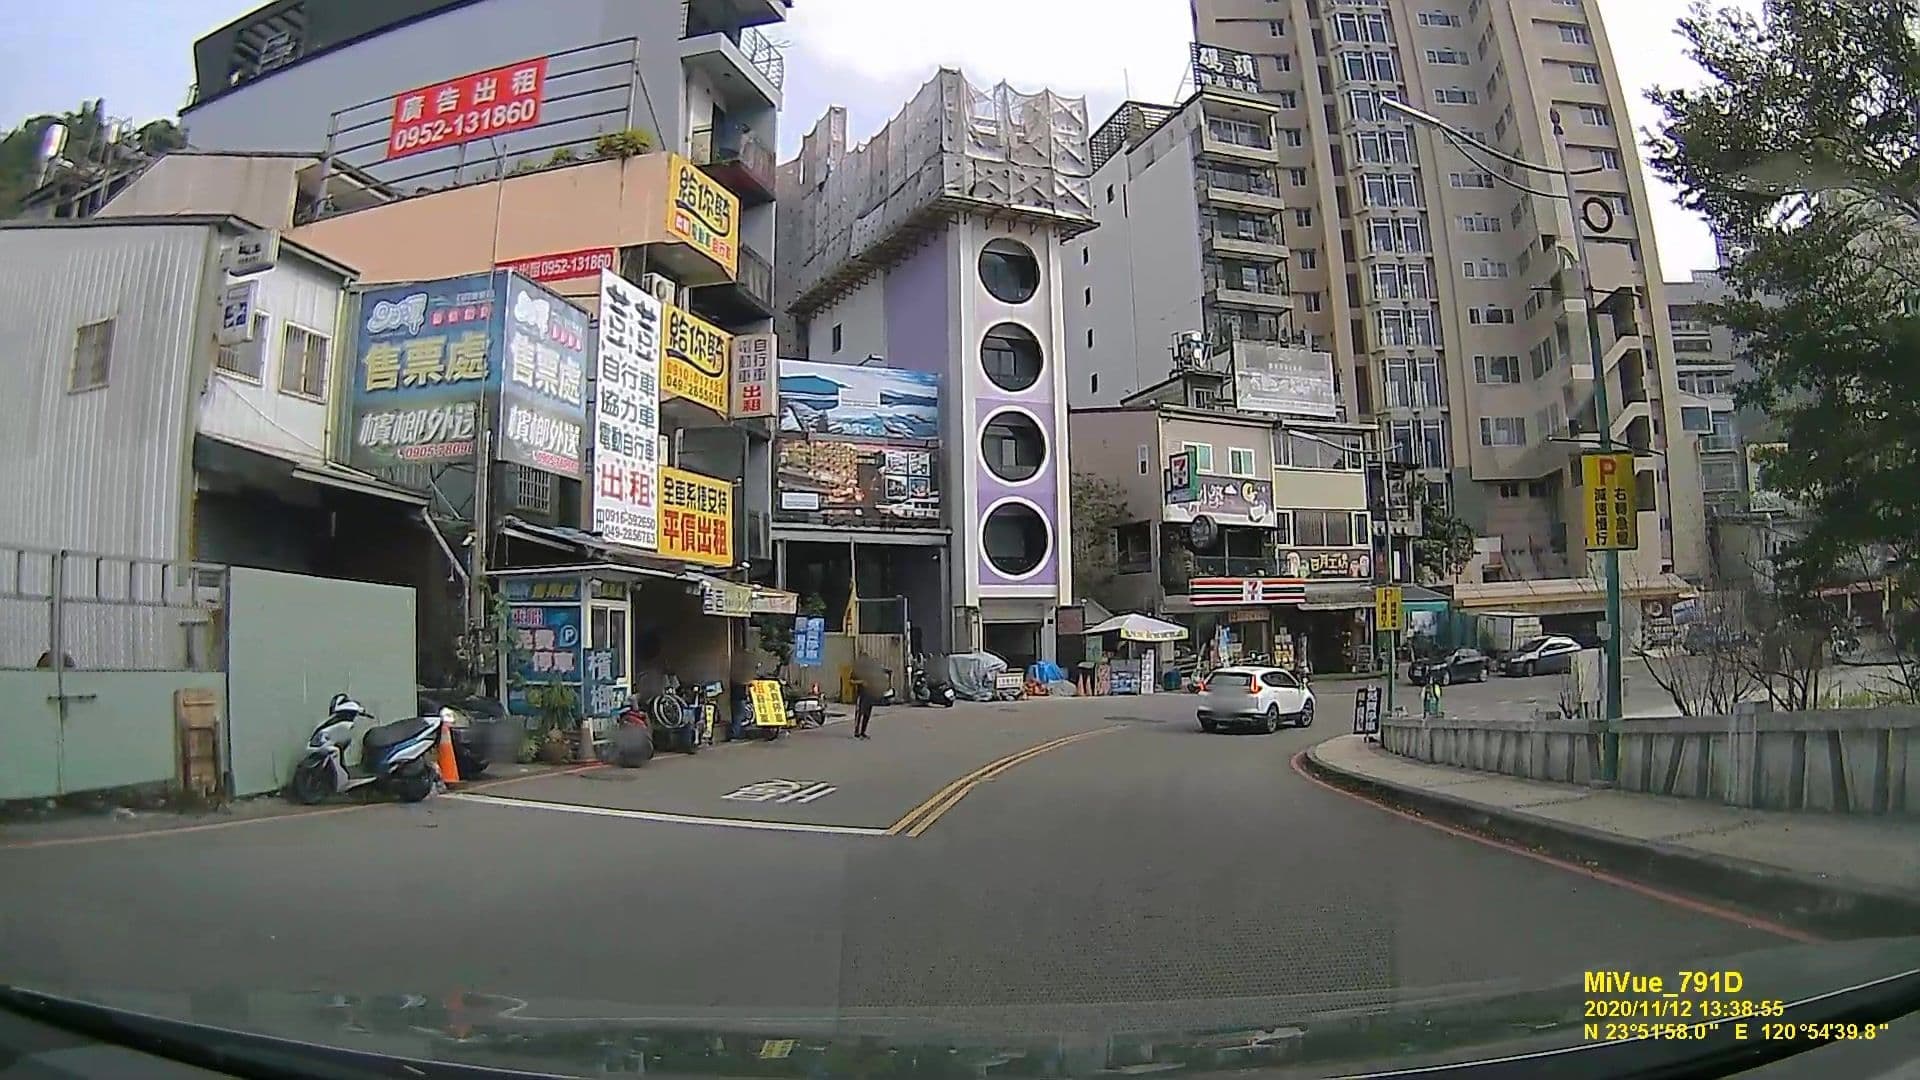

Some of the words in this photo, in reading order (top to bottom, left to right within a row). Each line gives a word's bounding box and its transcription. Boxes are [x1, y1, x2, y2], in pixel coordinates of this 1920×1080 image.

[400, 66, 538, 123] 廣告出租
[394, 98, 536, 152] 0952-131860
[541, 253, 612, 276] 0952-131860
[364, 331, 489, 393] 售票處
[511, 333, 582, 406] 售票處
[602, 353, 656, 397] 自行車
[600, 388, 656, 430] 協力車
[742, 385, 762, 411] 出租
[359, 400, 477, 447] 檳榔外送
[508, 405, 582, 458] 檳榔外送
[599, 421, 656, 464] 電動自行車
[600, 462, 653, 509] 出租
[1598, 458, 1616, 486] P
[663, 509, 728, 558] 平價出租
[565, 629, 576, 643] P
